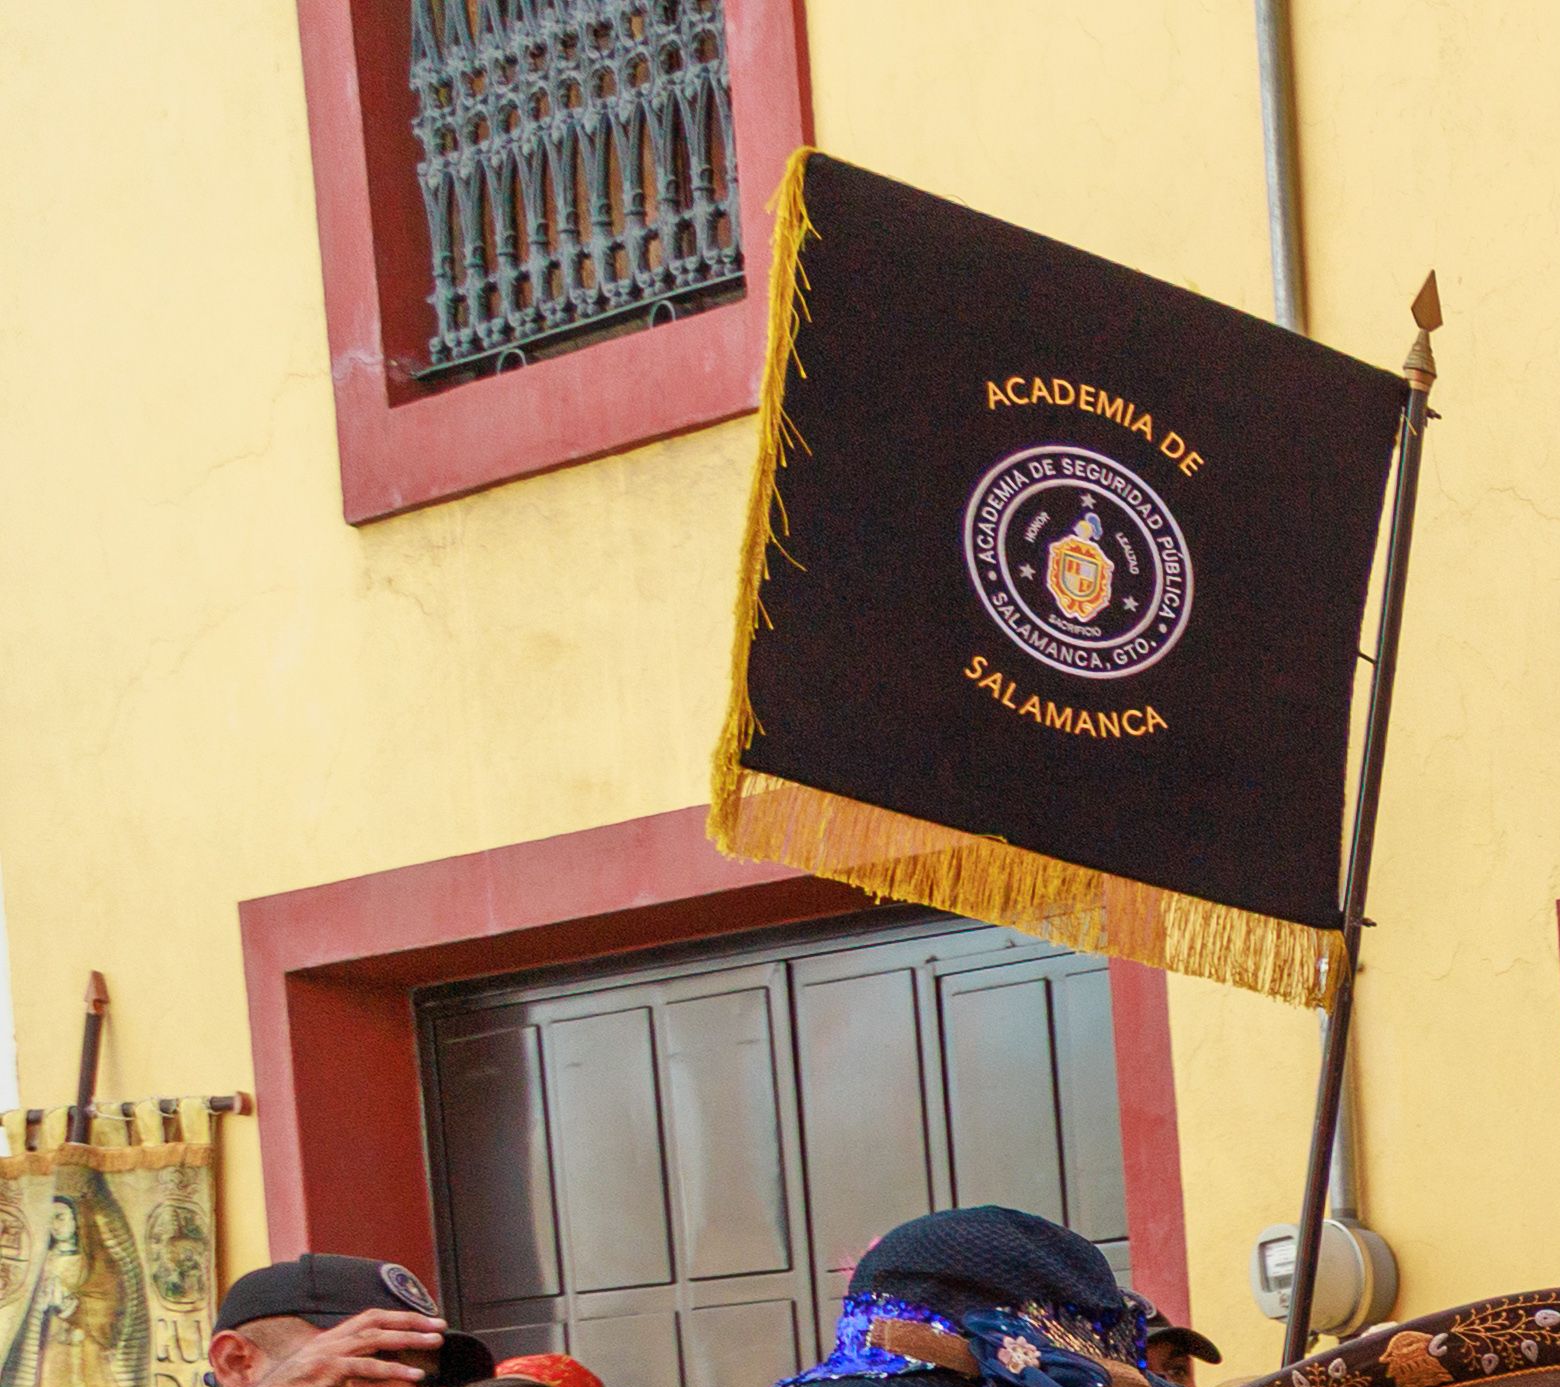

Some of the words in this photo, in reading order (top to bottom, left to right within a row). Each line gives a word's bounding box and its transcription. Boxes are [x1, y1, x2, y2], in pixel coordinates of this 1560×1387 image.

[986, 376, 1153, 442] ACADEMIA
[1159, 431, 1205, 478] DE
[977, 469, 1030, 564] ACADEMIA
[1028, 458, 1056, 479] DE
[1061, 457, 1163, 530] SEGURIDAD
[1157, 536, 1184, 619] PÚBLICA
[1024, 511, 1051, 543] HONOR
[1115, 532, 1139, 575] LEALTAD
[992, 592, 1111, 670] SALAMANCA,
[1113, 638, 1157, 665] GTO.
[1048, 614, 1102, 637] SACRIFICIO
[963, 655, 1168, 738] SALAMANCA
